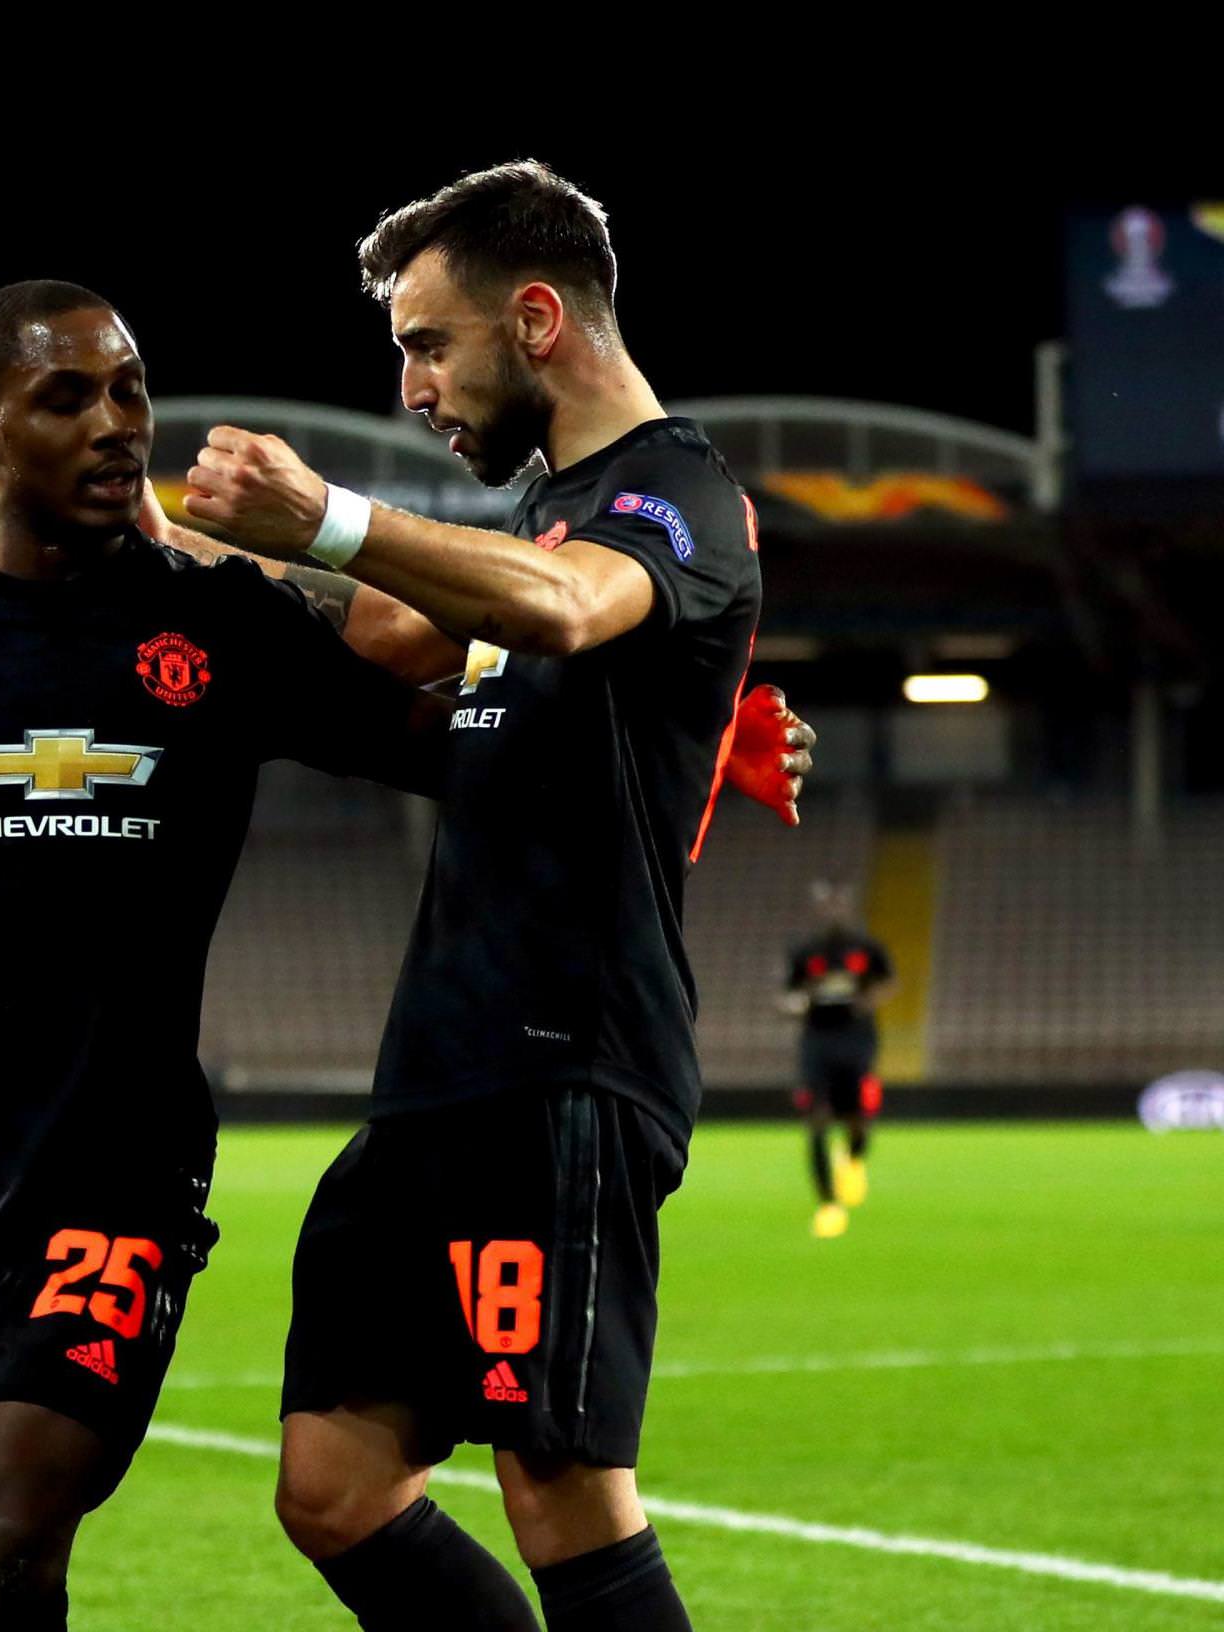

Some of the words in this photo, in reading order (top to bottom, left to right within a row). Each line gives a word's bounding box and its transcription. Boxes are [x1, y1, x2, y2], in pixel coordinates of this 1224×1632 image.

[642, 501, 692, 558] RESPECT
[155, 686, 196, 701] UNITED
[29, 1228, 164, 1340] 25
[449, 1239, 545, 1355] 18
[66, 1348, 119, 1385] adidas
